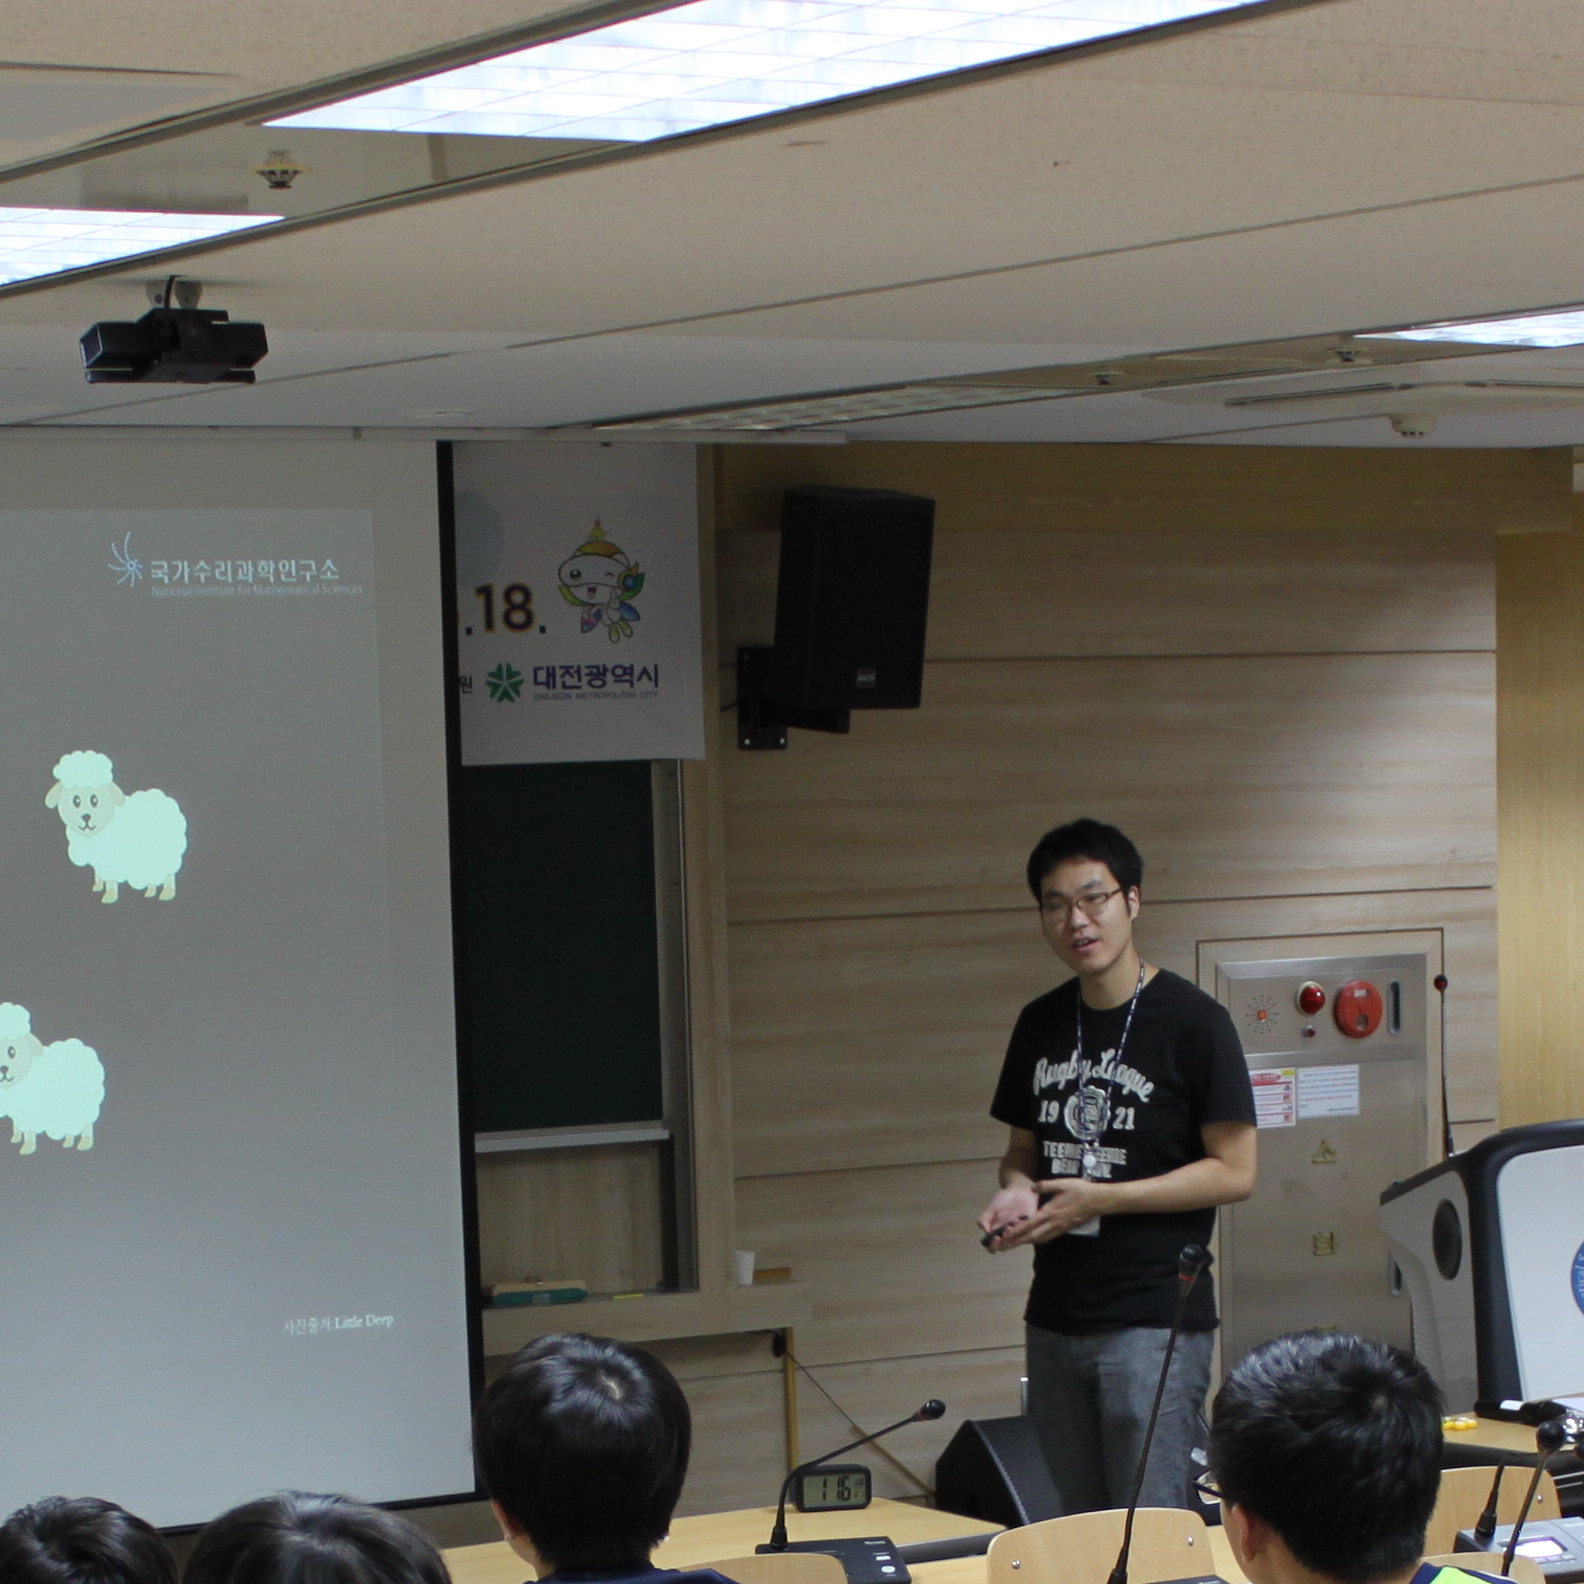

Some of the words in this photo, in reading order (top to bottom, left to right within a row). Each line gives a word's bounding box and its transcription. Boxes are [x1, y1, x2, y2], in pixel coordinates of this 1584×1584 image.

[151, 559, 339, 584] 국가수리과학연구소
[457, 583, 546, 635] .18.
[532, 664, 659, 690] 대전광역시
[1037, 1100, 1060, 1123] 19
[1112, 1106, 1135, 1130] 21
